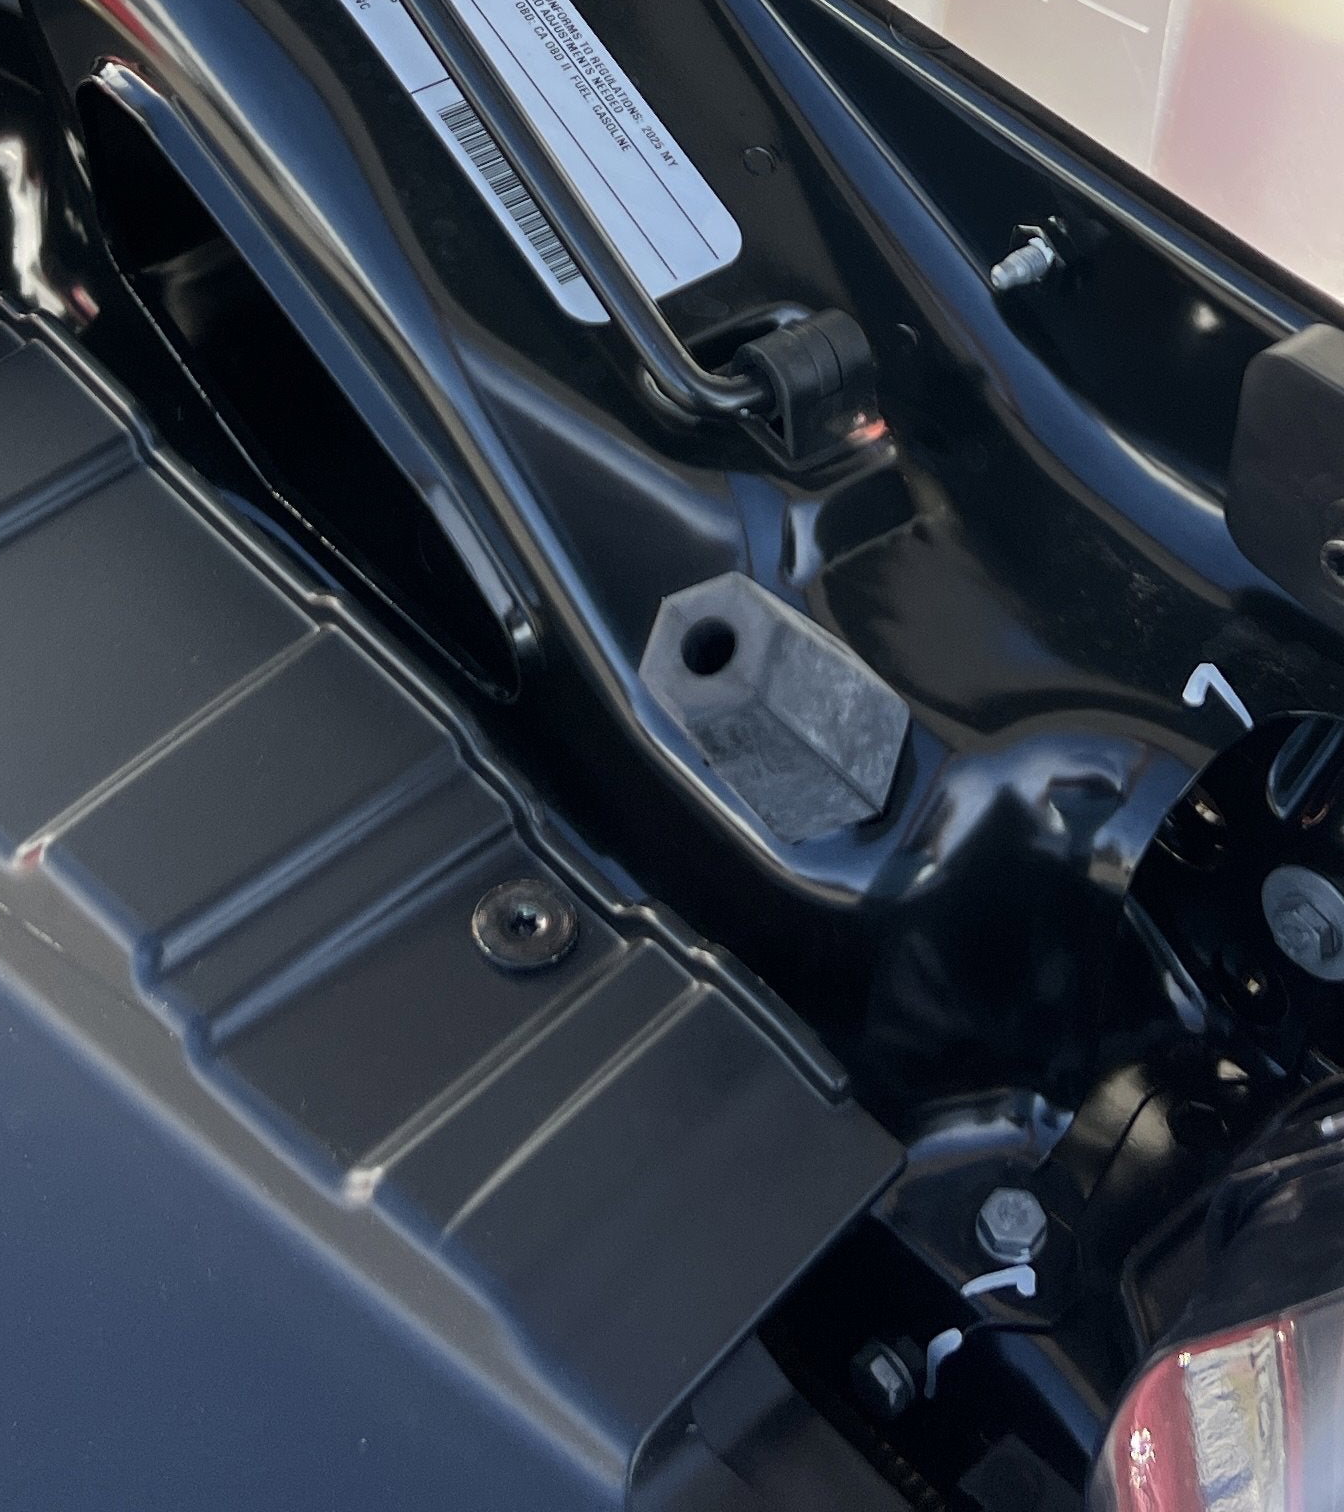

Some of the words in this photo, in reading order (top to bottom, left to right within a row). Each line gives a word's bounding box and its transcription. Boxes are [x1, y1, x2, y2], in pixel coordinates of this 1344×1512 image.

[534, 26, 547, 41] CA
[545, 41, 563, 62] OBD
[592, 104, 633, 152] GASOLINE
[541, 7, 596, 75] ADJUSTMENTS
[592, 77, 624, 114] NEEDED
[580, 40, 594, 55] TO
[590, 54, 644, 125] REGULATIONS:
[641, 126, 663, 150] 2025
[660, 150, 678, 169] MY
